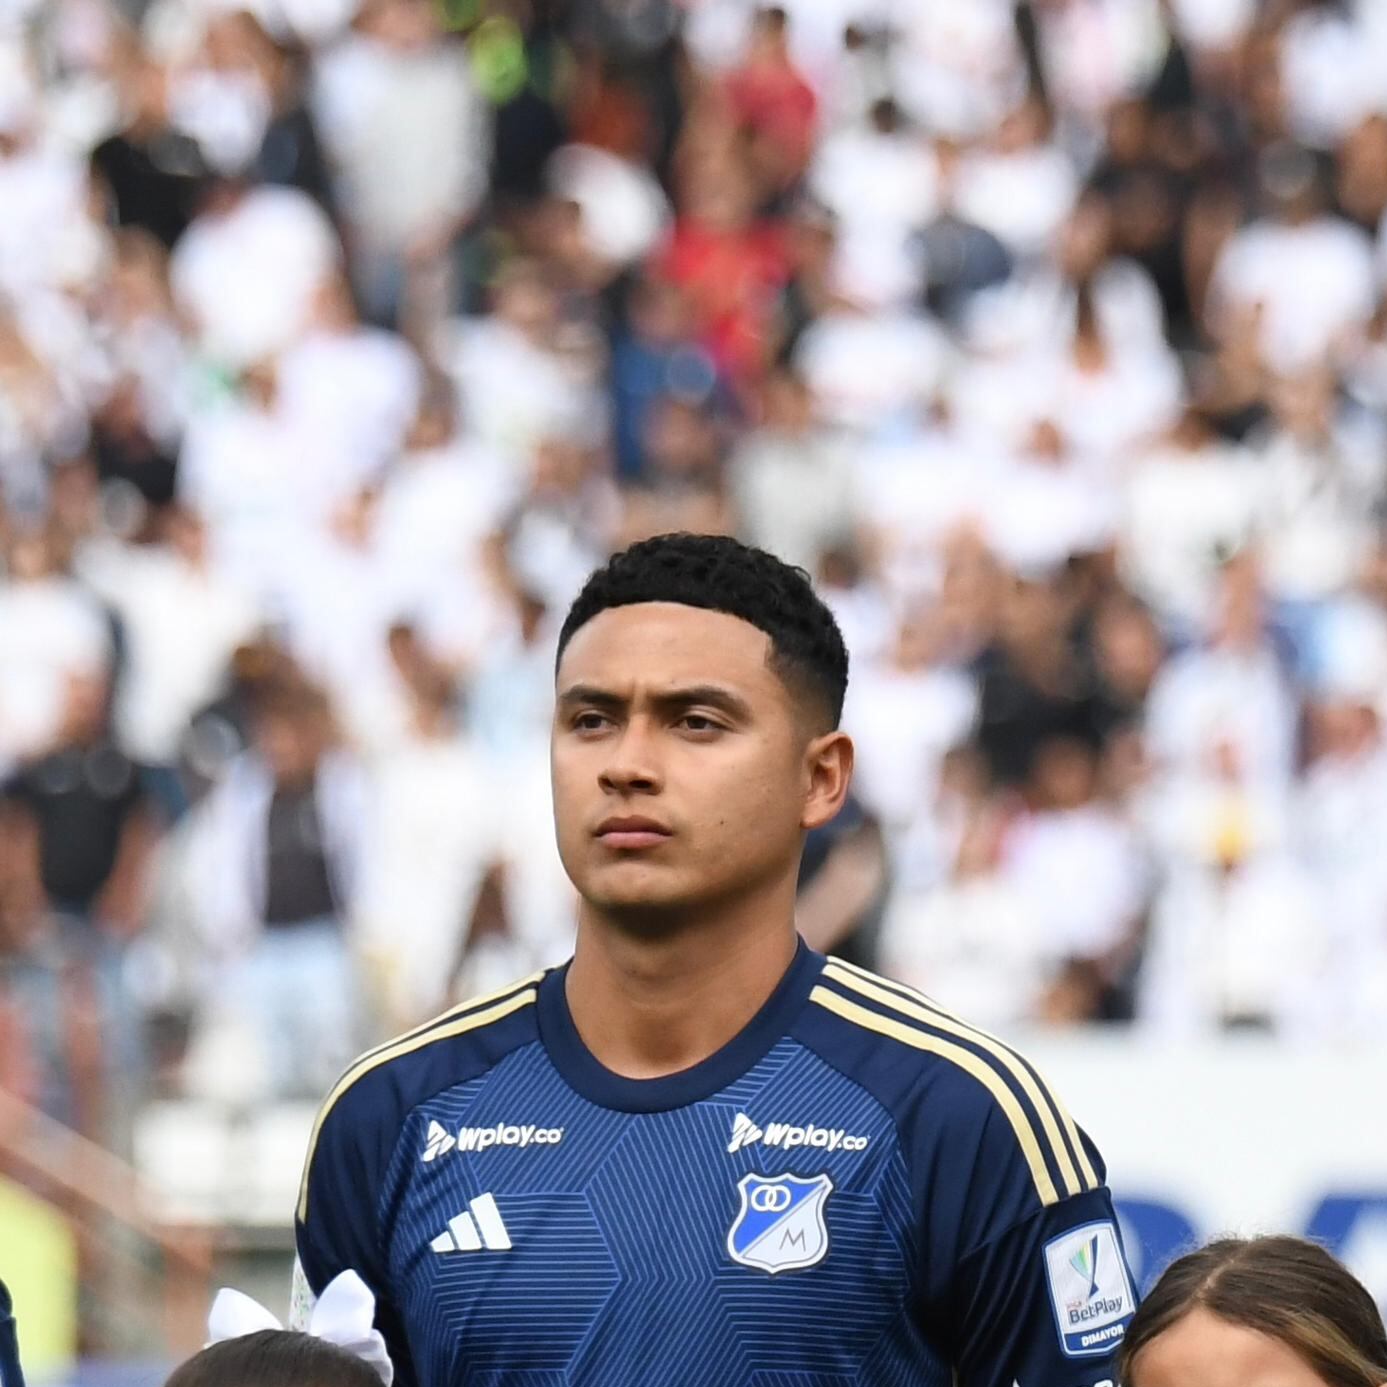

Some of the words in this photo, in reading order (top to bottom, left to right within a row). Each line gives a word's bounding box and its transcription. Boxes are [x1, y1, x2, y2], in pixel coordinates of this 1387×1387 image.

[457, 1122, 562, 1153] Wplay.co
[764, 1119, 869, 1153] Wplay.co
[1068, 1296, 1124, 1325] BetPlay
[1081, 1324, 1124, 1347] DIMAYOR
